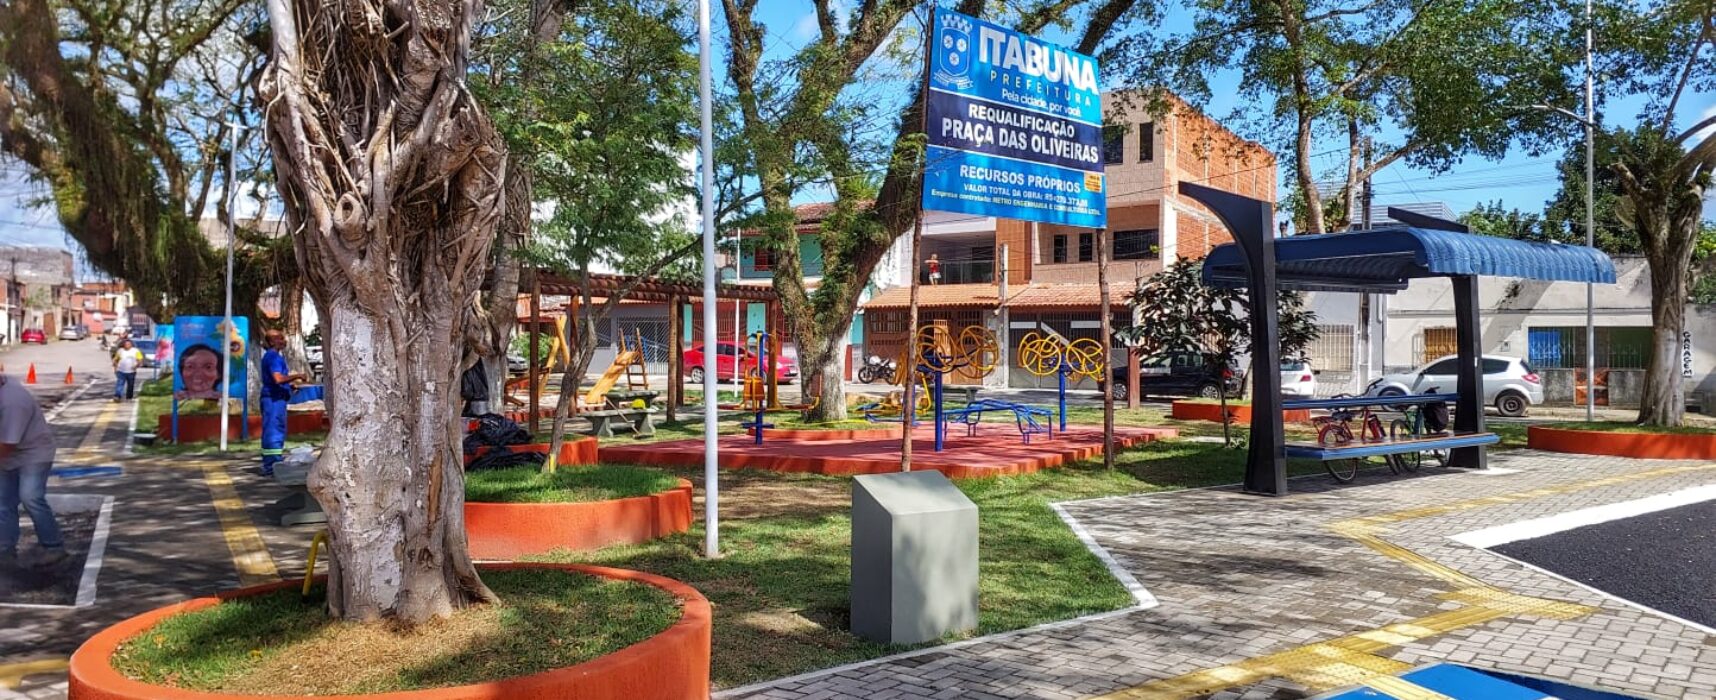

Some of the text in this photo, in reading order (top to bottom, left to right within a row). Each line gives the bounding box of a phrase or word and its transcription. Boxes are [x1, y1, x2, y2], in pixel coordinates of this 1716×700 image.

[979, 25, 1099, 96] ITABUNA
[990, 70, 1091, 106] PREFEITURA
[1001, 89, 1019, 102] Pela
[1049, 102, 1064, 113] por
[968, 103, 1075, 138] REQUALIFICAÇÃO
[941, 118, 1099, 164] PRAÇA DAS OLIVEIRAS
[960, 164, 1025, 186] RECURSOS
[1027, 174, 1081, 194] PRÓPRIOS
[963, 183, 988, 193] VALOR
[989, 186, 1010, 197] TOTAL
[1012, 188, 1021, 198] DA
[1022, 190, 1043, 200] OBRA:
[992, 197, 1012, 205] METRO
[1682, 331, 1692, 375] GARAGEM
